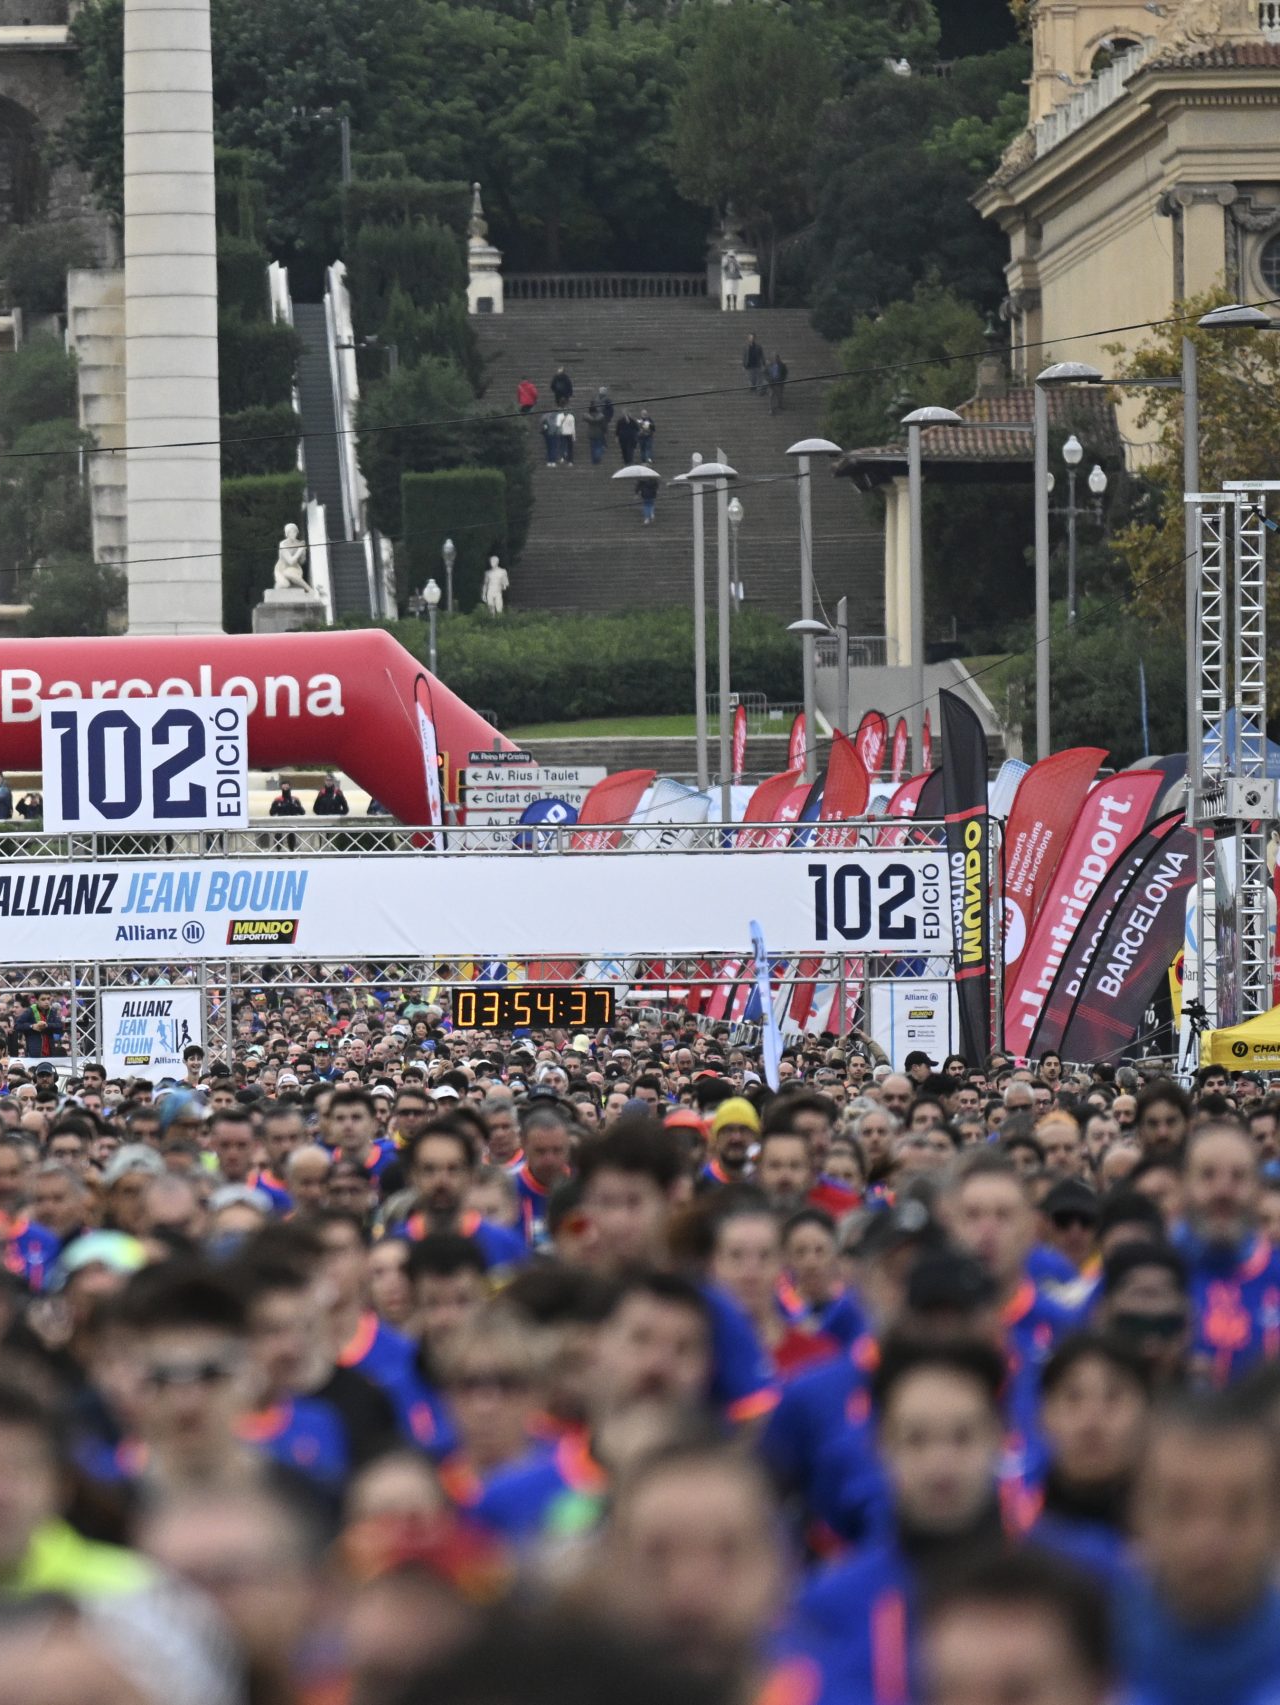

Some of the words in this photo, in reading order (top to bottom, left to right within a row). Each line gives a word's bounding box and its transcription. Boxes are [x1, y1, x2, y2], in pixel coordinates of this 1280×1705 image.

[51, 709, 207, 820] 102
[209, 707, 241, 817] EDICIÓ
[486, 771, 504, 781] Av.
[508, 770, 533, 781] Rius
[536, 770, 540, 781] i
[544, 770, 579, 781] Taulet
[486, 793, 520, 803] Ciutat
[1012, 820, 1044, 893] Metropolitans
[1024, 883, 1033, 897] de
[1031, 829, 1053, 881] Barcelona
[121, 871, 200, 914] JEAN
[205, 870, 309, 912] BOUIN
[808, 863, 917, 941] 102
[918, 863, 940, 939] EDICIÓ
[115, 924, 178, 941] Allianz
[233, 920, 294, 934] MUNDO
[233, 933, 279, 941] DEPORTIVO
[1096, 850, 1189, 998] BARCELONA
[121, 1000, 173, 1017] ALLIANZ
[457, 991, 610, 1027] 03:54:37
[116, 1018, 148, 1036] JEAN
[113, 1037, 154, 1055] BOUIN
[1253, 1044, 1280, 1054] CHA
